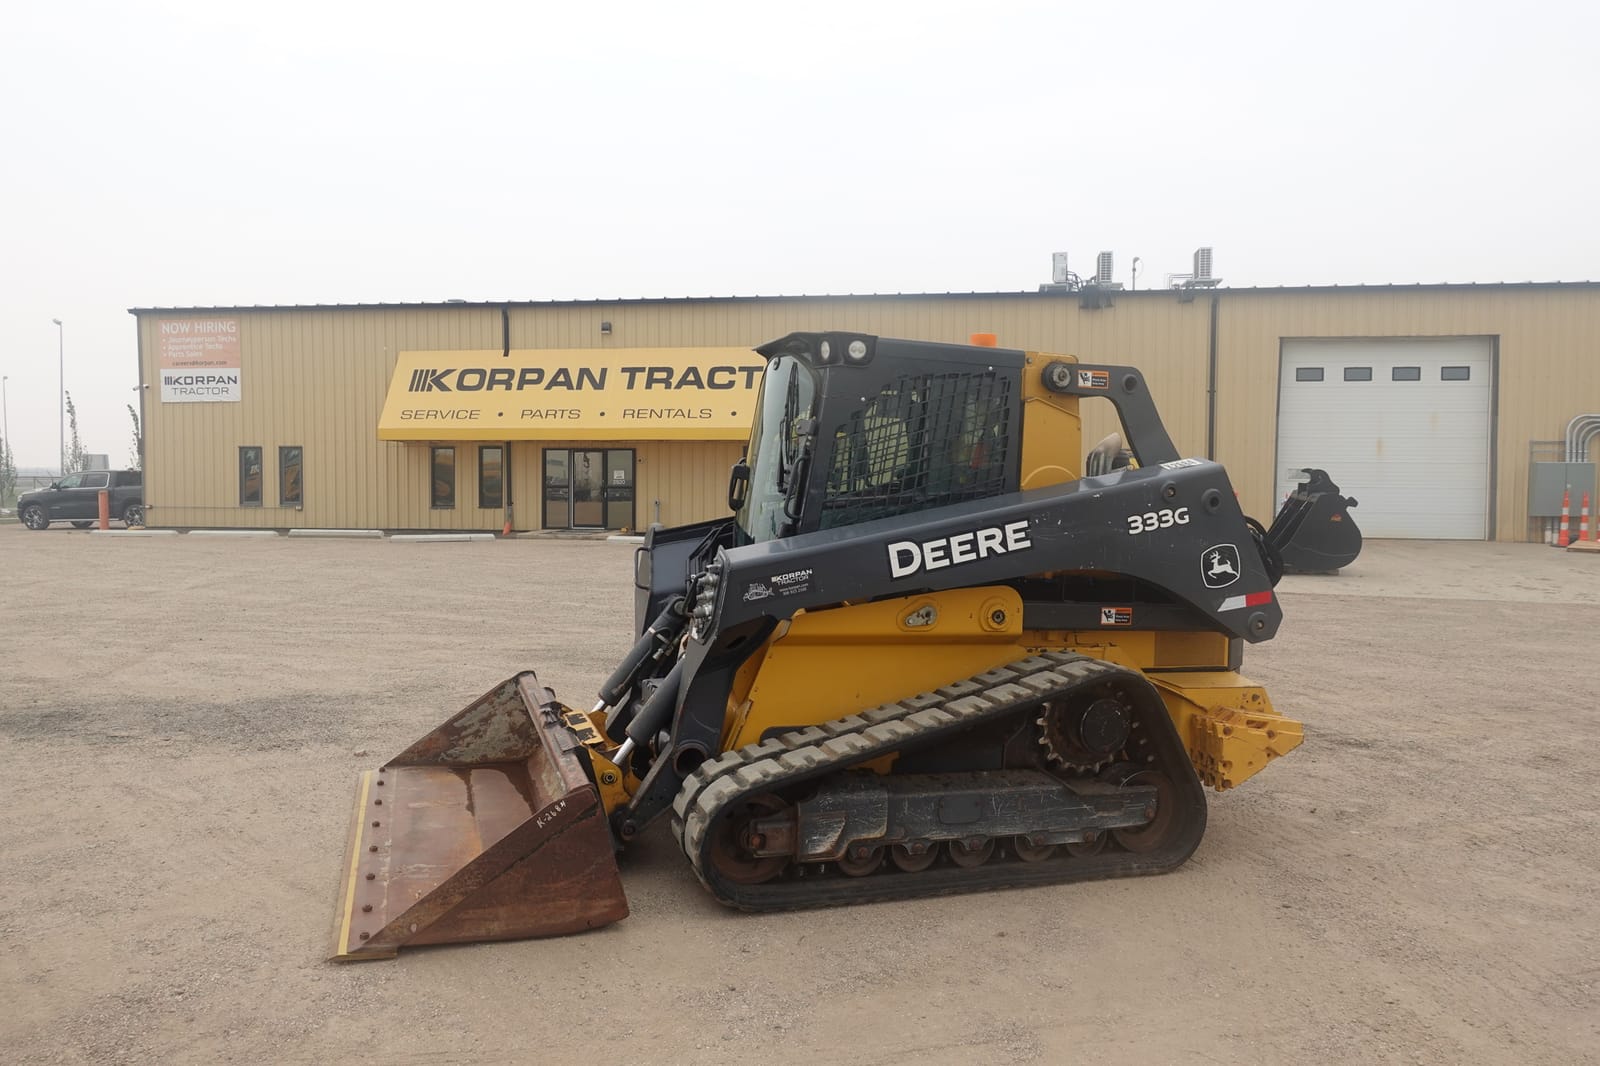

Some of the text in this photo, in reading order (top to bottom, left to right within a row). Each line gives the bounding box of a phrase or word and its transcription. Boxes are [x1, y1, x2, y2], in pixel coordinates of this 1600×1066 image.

[161, 321, 236, 334] NOW HIRING
[165, 376, 237, 385] KORPAN
[409, 366, 764, 392] KORPAN TRACT
[172, 387, 229, 395] TRACTOR
[400, 408, 712, 420] SERVICE PARTS RENTALS
[1127, 507, 1190, 535] 333G
[888, 520, 1031, 578] DEERE
[771, 568, 813, 583] KORPAN
[777, 575, 809, 586] TRACTOR
